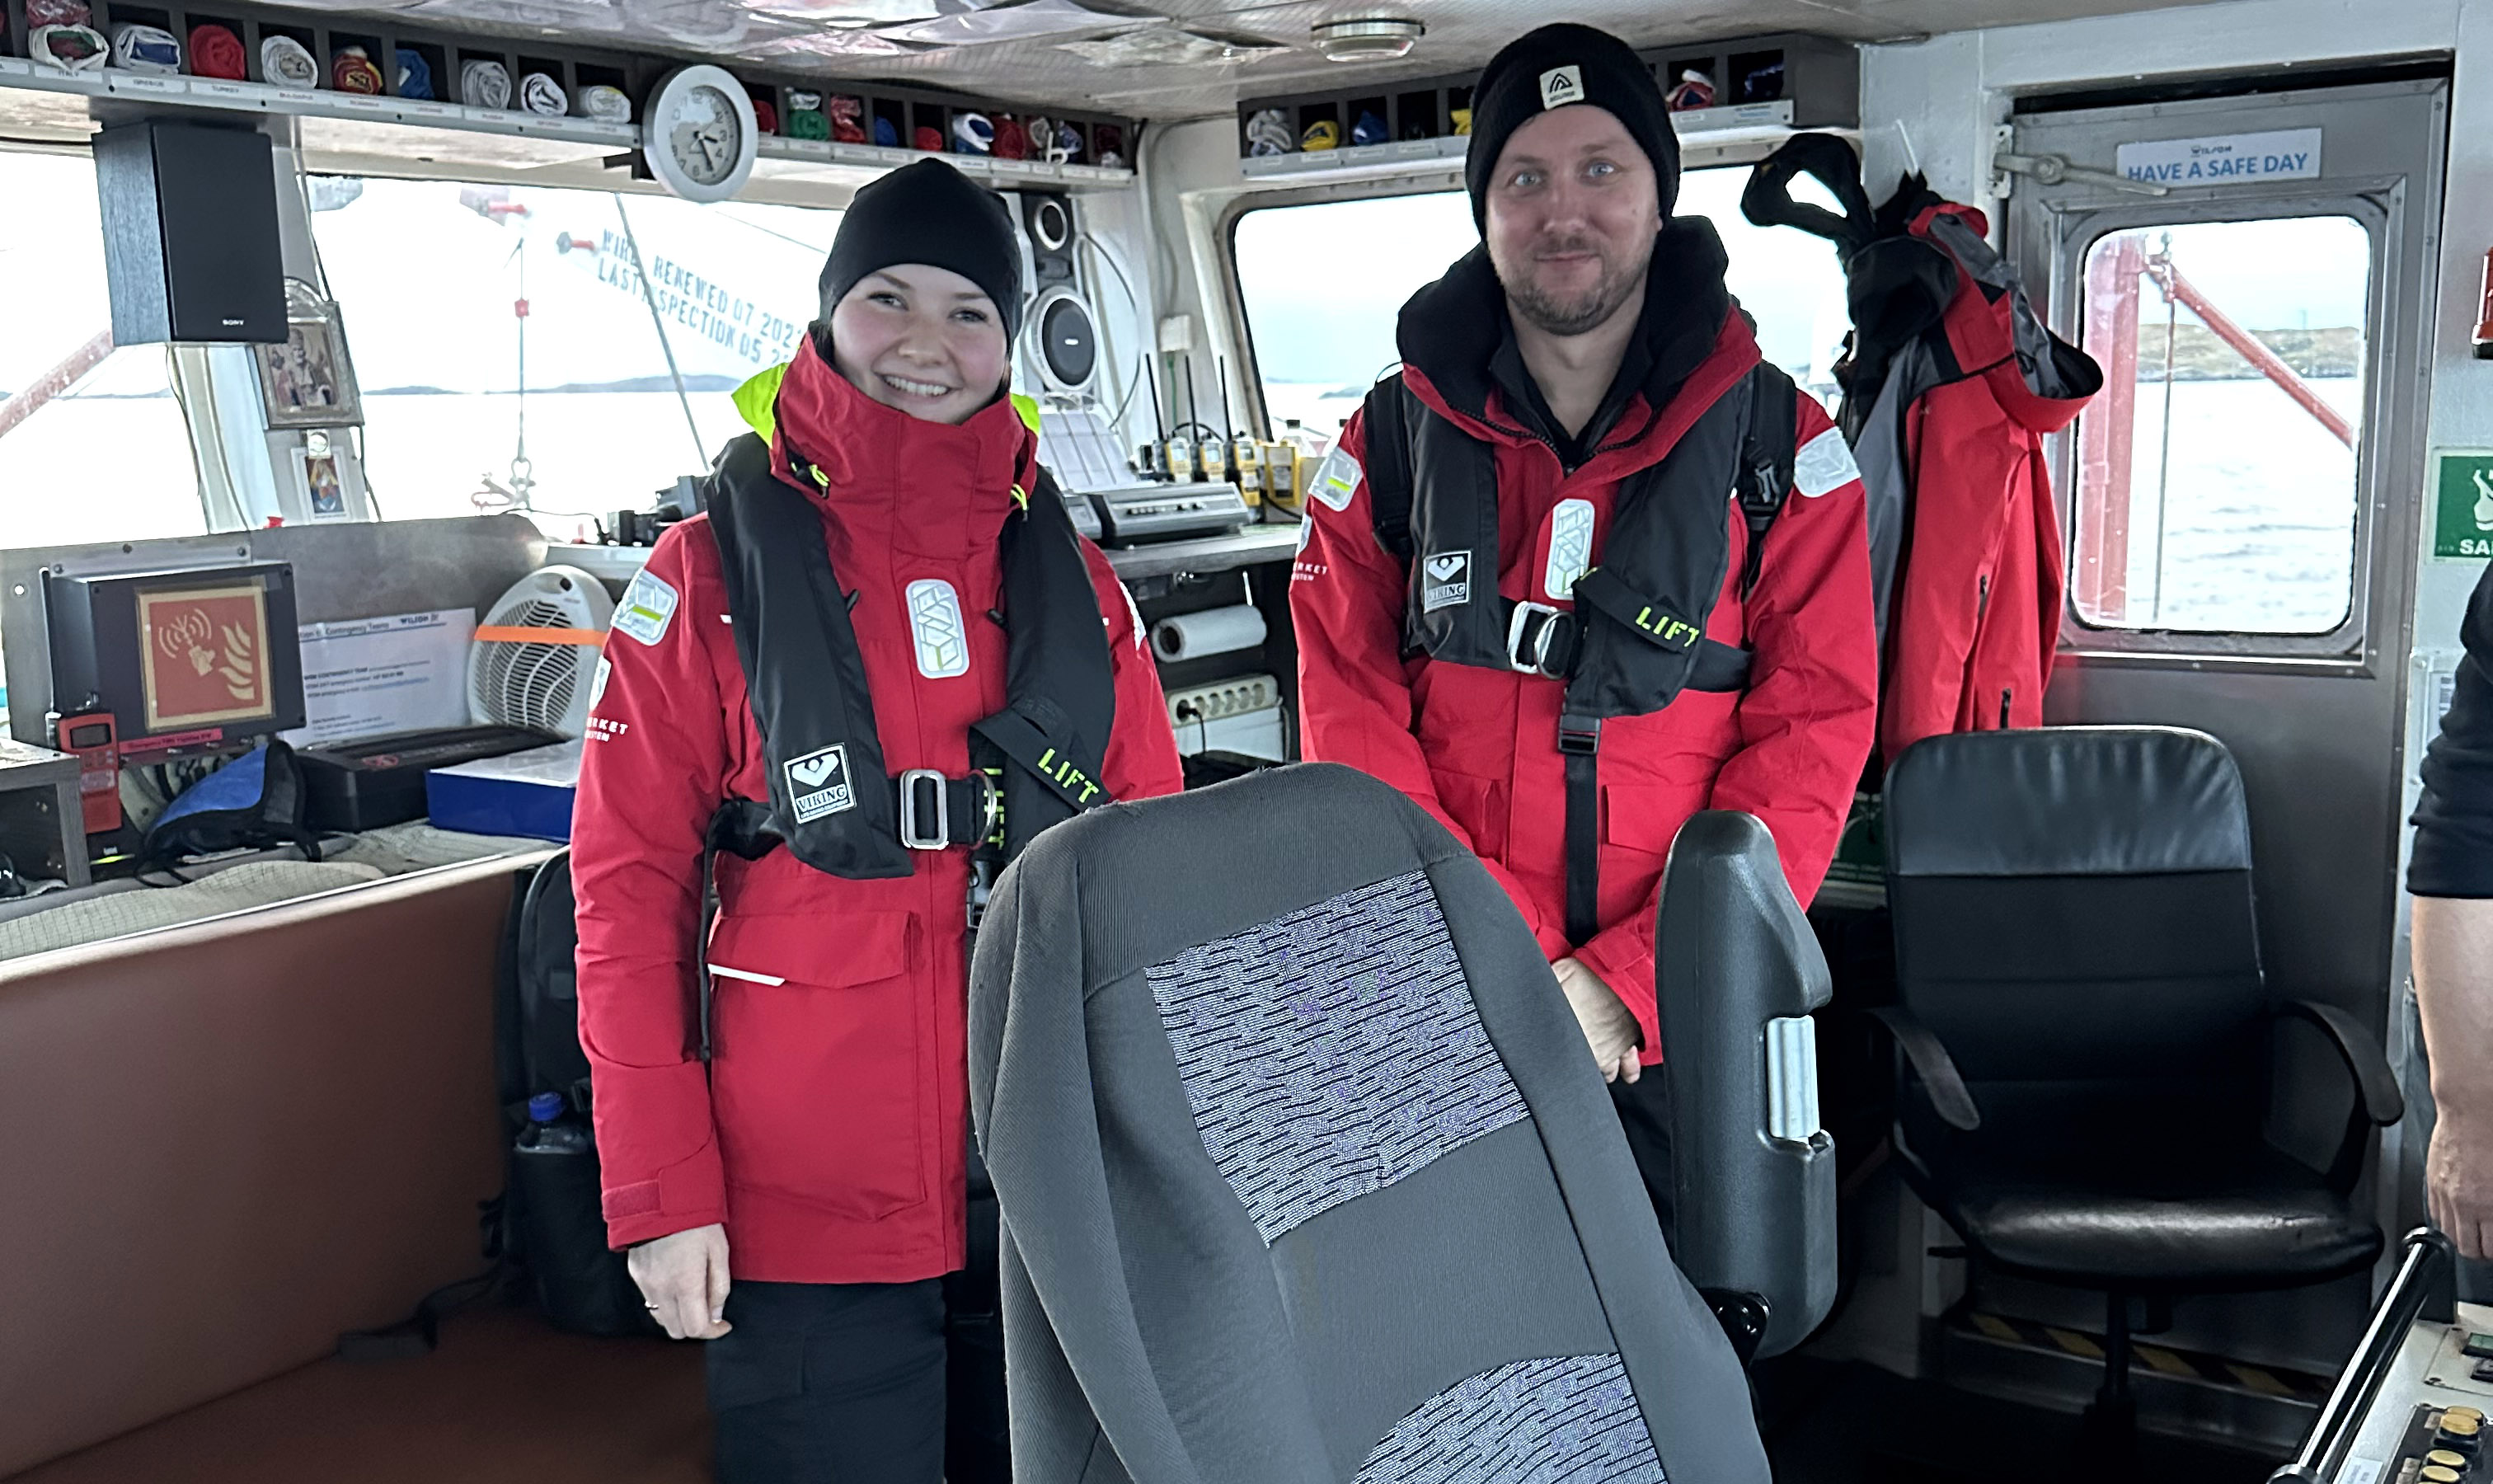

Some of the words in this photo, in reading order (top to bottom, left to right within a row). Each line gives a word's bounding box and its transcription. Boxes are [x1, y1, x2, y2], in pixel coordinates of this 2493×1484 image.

[719, 130, 727, 142] 3
[715, 148, 723, 158] 4
[692, 165, 700, 176] 6
[2128, 163, 2183, 182] HAVE
[2187, 162, 2203, 179] A
[2207, 157, 2258, 177] SAFE
[2264, 153, 2308, 172] DAY
[598, 257, 641, 296] LAST
[739, 332, 763, 364] 05
[653, 255, 728, 314] RENEWED
[733, 298, 755, 326] 07
[759, 312, 802, 349] 202
[2458, 538, 2493, 555] SA
[1427, 585, 1465, 602] VIKING
[1636, 606, 1700, 648] LIFT
[1037, 748, 1100, 804] LIFT
[798, 786, 845, 810] VIKING
